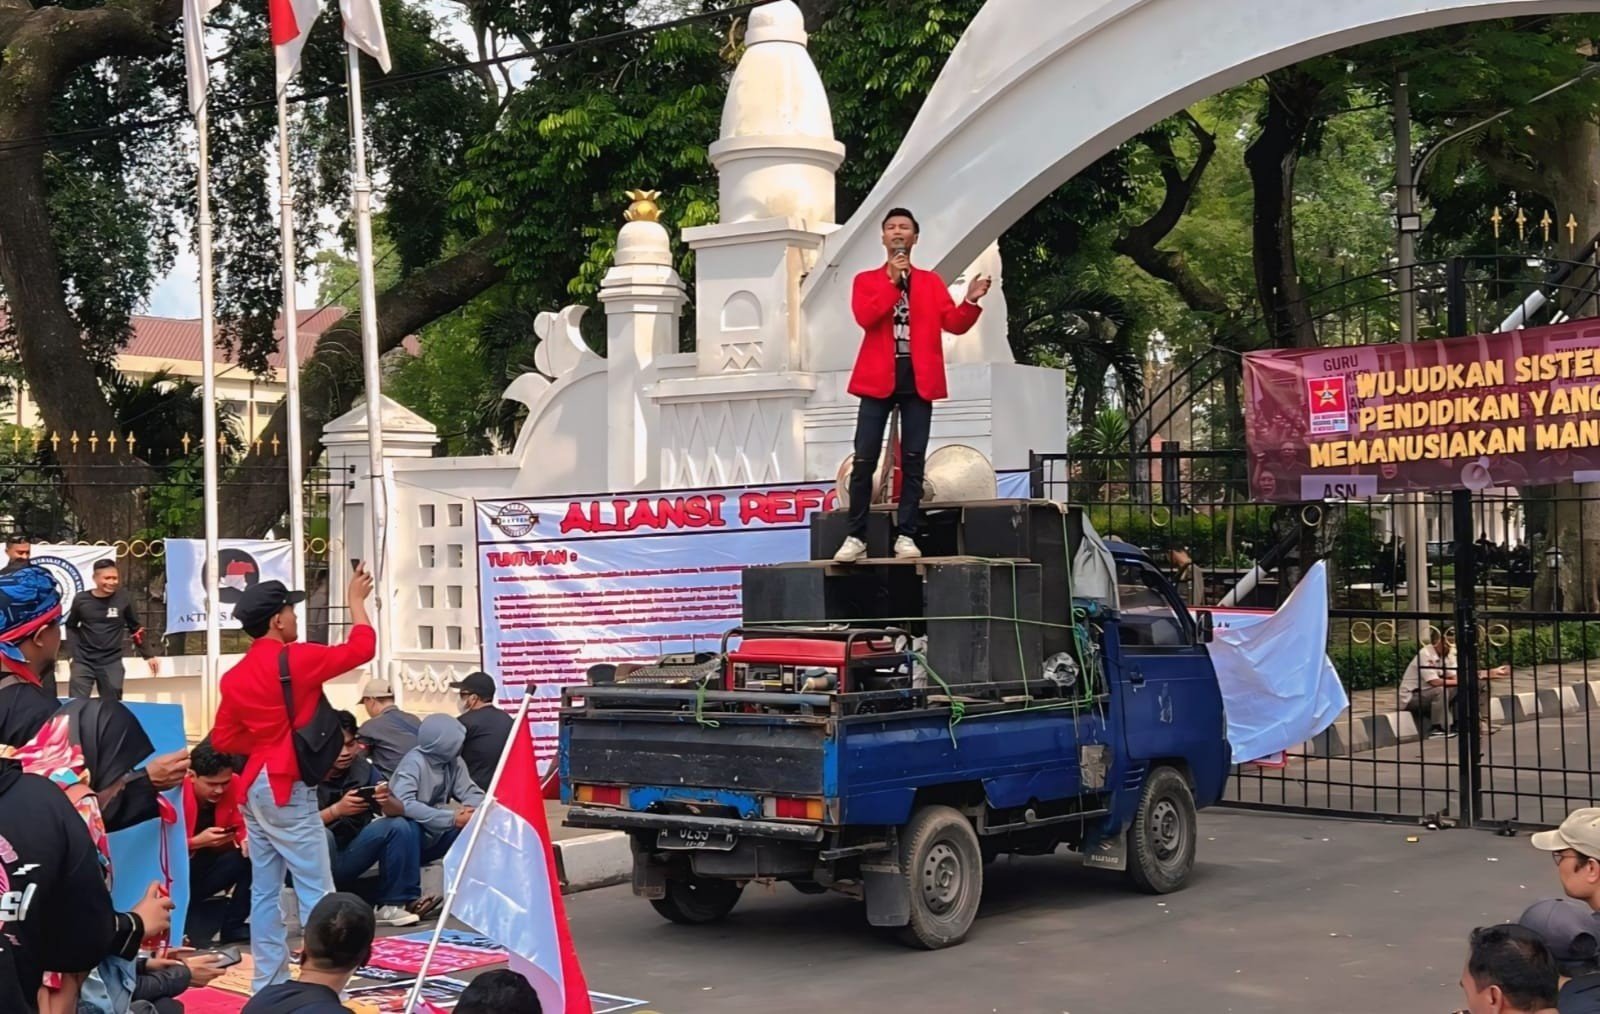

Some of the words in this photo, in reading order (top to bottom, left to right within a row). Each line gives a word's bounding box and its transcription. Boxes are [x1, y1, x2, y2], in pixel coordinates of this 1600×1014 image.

[1323, 354, 1358, 372] GURU
[1356, 361, 1504, 398] WUJUDKAN
[1359, 392, 1519, 432] PENDIDIKAN
[1310, 426, 1525, 468] MEMANUSIAKAN
[1536, 420, 1600, 450] MAN
[1324, 483, 1356, 498] ASN
[560, 494, 726, 534] ALIANSI
[486, 549, 567, 568] TUNTUTAN
